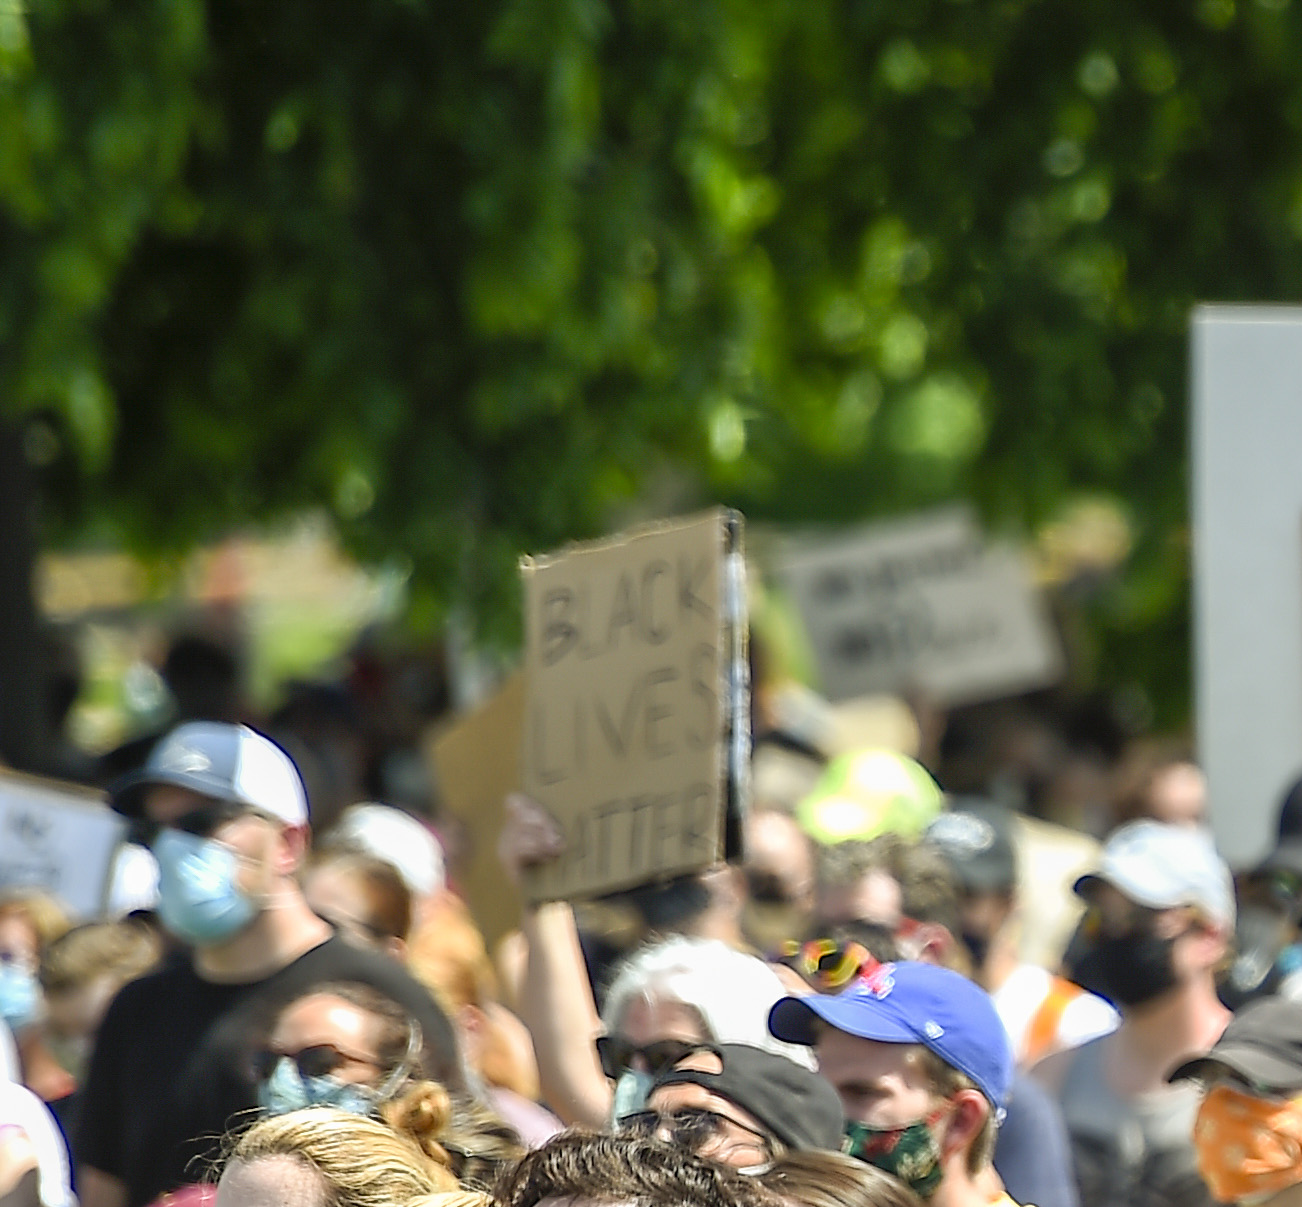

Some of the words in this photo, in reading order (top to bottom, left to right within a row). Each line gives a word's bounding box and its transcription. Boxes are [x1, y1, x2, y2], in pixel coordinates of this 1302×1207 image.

[541, 555, 716, 667] BLACK
[532, 642, 717, 786] LIVES
[562, 783, 716, 880] ATTER
